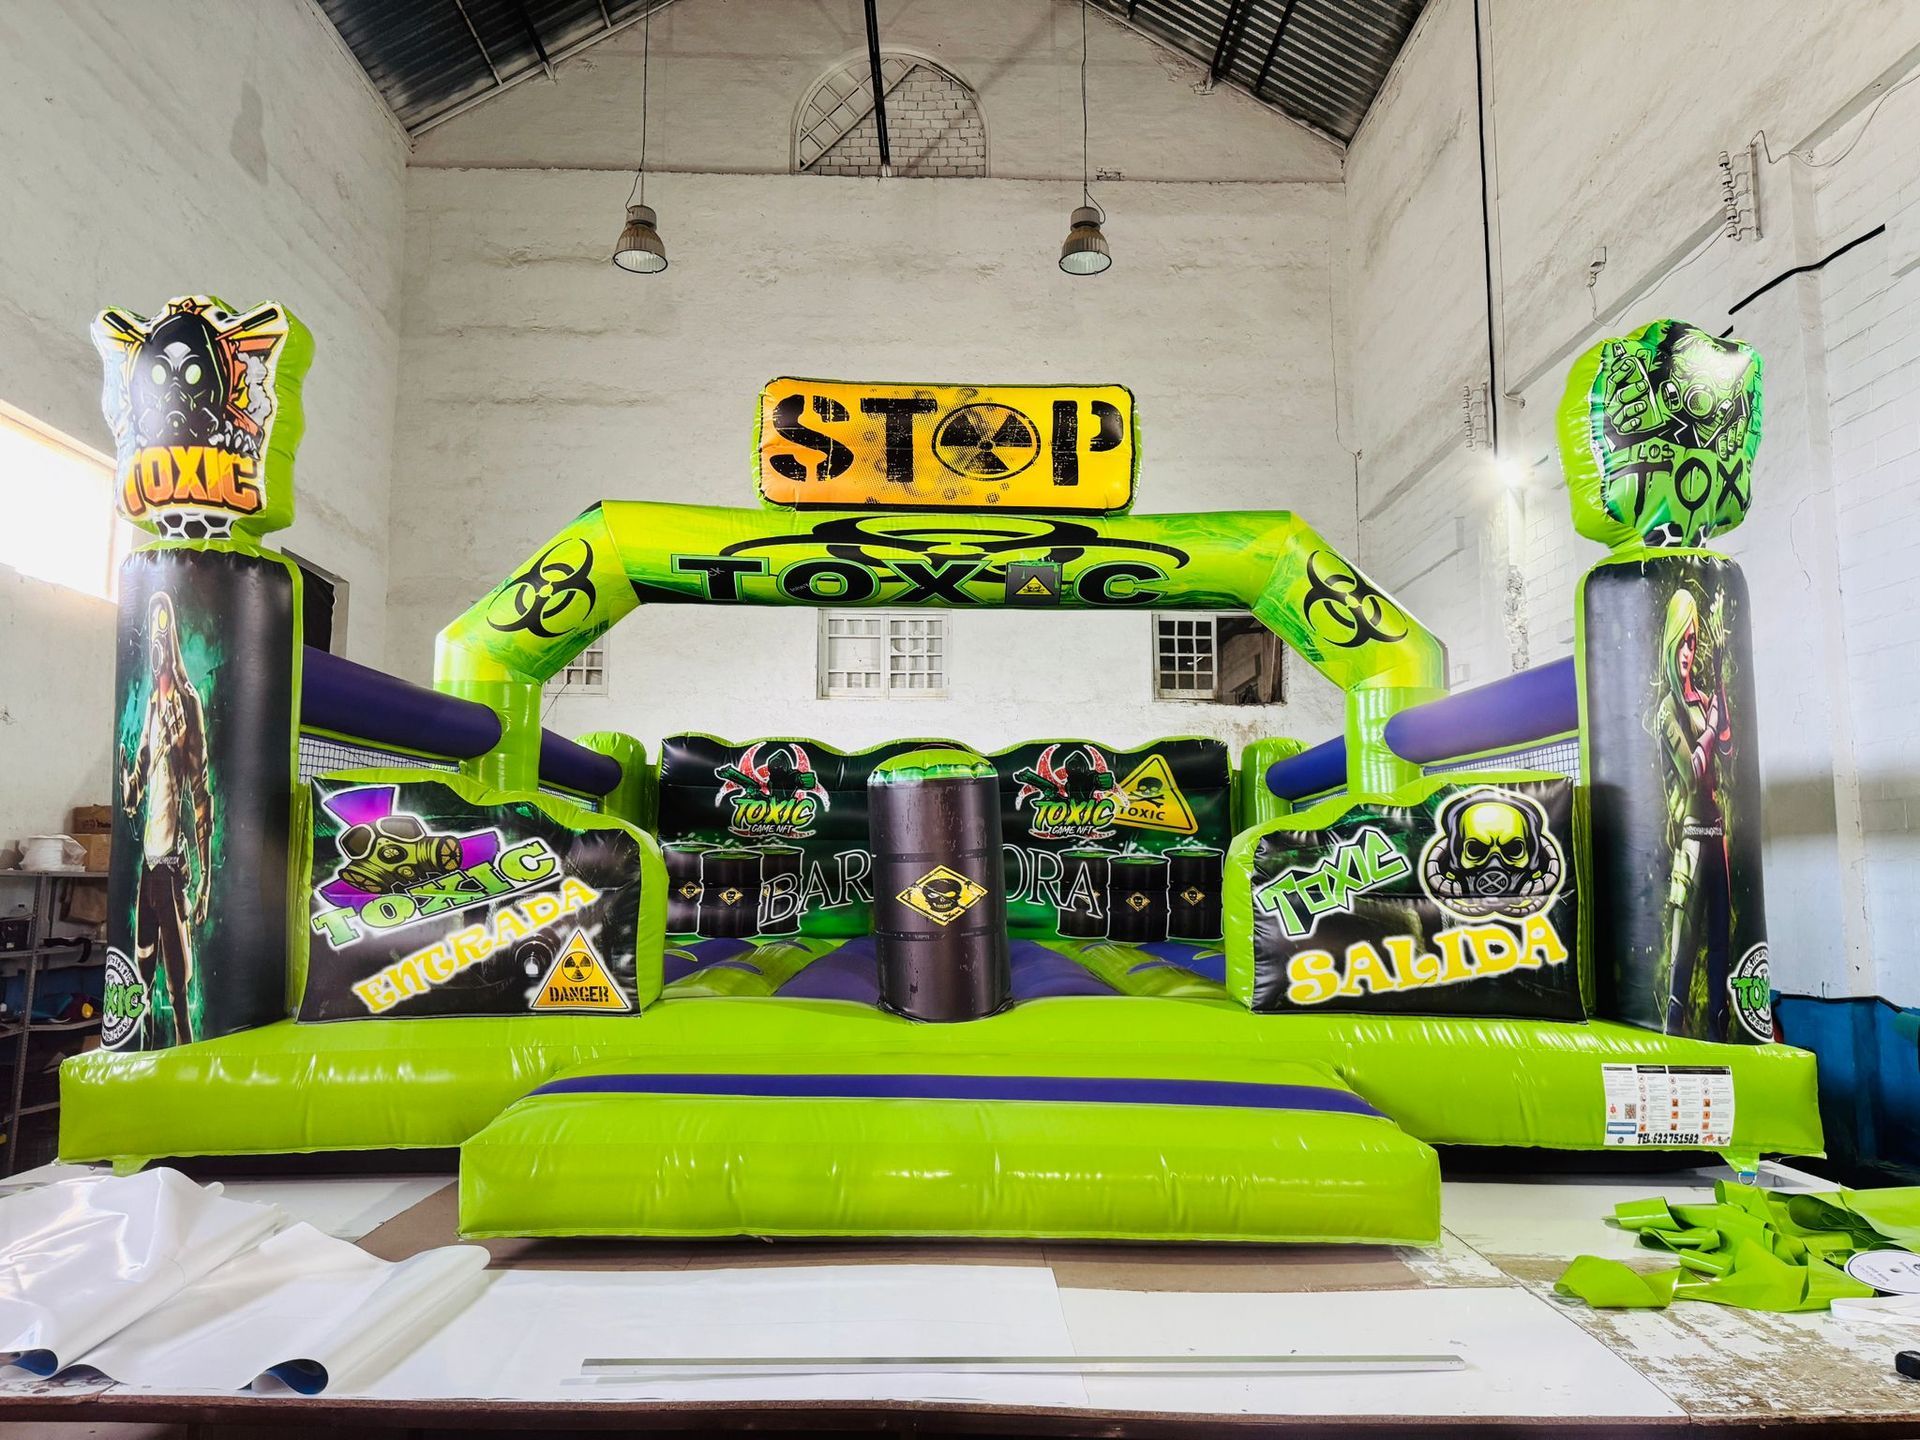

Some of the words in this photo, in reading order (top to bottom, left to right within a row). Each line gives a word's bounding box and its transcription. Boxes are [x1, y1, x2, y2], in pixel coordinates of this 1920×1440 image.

[124, 445, 262, 516] TOXIC
[733, 796, 815, 828] TOXIC
[751, 823, 774, 834] GAME
[775, 823, 794, 833] NFT
[1033, 799, 1116, 829] TOXIC
[1118, 806, 1166, 821] TOXIC
[1051, 825, 1076, 835] GAME
[1077, 825, 1094, 834] NFT
[313, 840, 558, 947] TOXIC
[1256, 829, 1410, 937] TOXIC
[352, 878, 600, 1014] ENTRADA
[1288, 914, 1569, 1004] SALIDA
[104, 982, 146, 1018] XIC
[549, 986, 610, 1003] DANGER
[1731, 976, 1771, 1011] TOX
